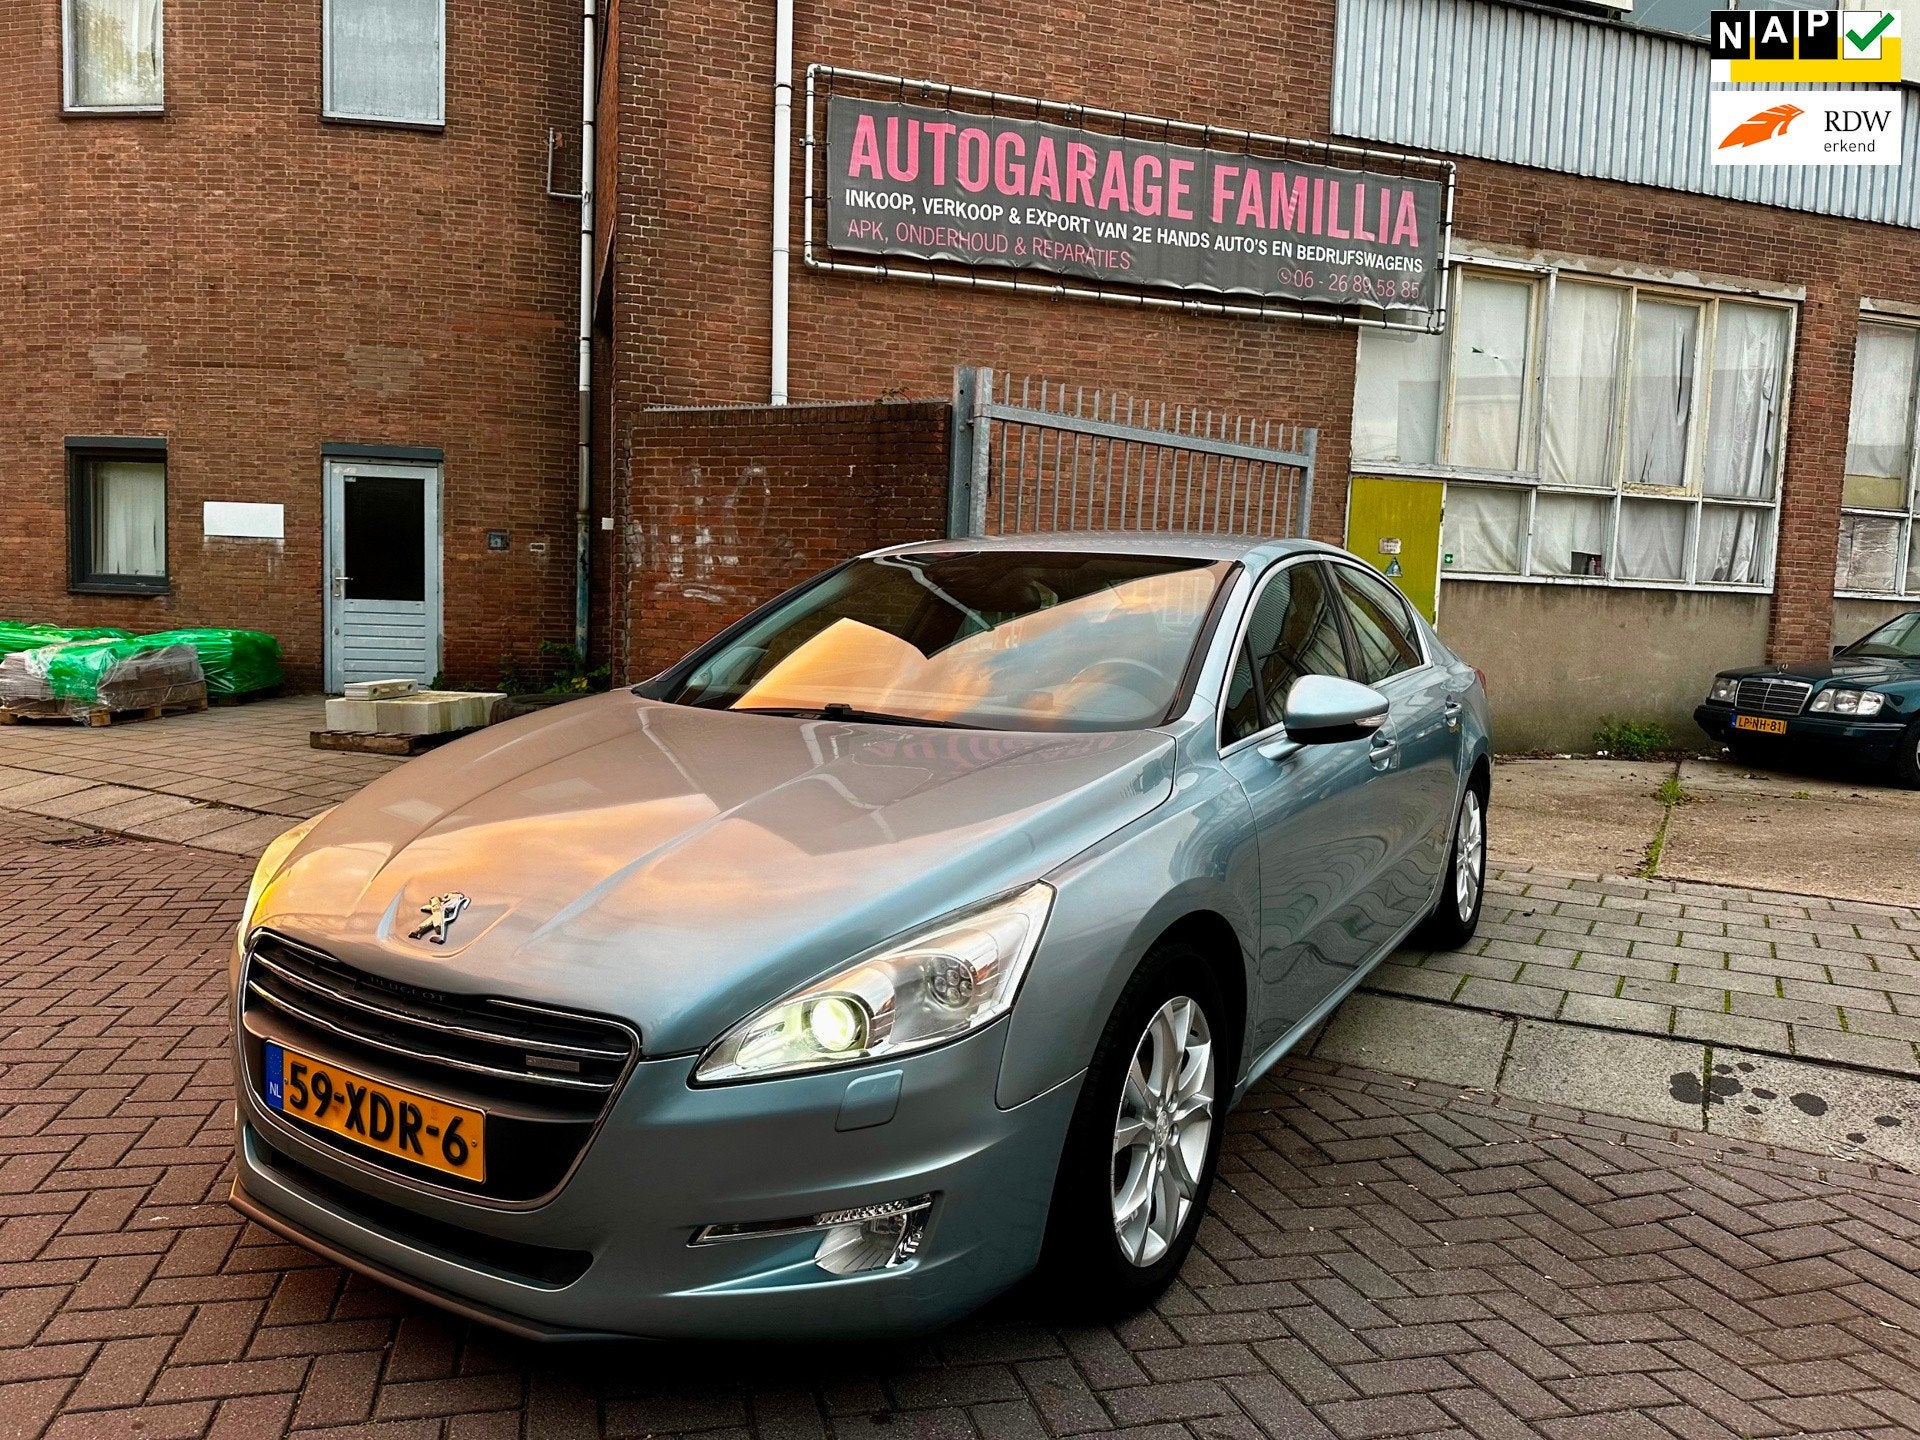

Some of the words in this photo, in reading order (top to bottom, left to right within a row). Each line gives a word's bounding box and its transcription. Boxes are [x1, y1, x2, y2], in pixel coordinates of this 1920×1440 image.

[847, 114, 1195, 220] AUTOGARAGE
[1212, 164, 1419, 248] FAMILLIA
[845, 188, 917, 215] INKOOP,
[922, 196, 1004, 222] VERKOOP
[1008, 207, 1022, 225] &
[1026, 208, 1091, 234] EXPORT
[1095, 220, 1128, 240] VAN
[1132, 225, 1152, 244] 2E
[1157, 227, 1210, 249] HANDS
[1214, 234, 1268, 255] AUTO'S
[1272, 240, 1293, 258] EN
[1296, 244, 1424, 273] BEDRIJFSWAGENS
[847, 218, 889, 243] APK,
[895, 222, 1009, 253] ONDERHOUD
[1014, 237, 1027, 256] &
[1032, 237, 1131, 270] REPARATIES
[1293, 269, 1314, 289] 06
[1328, 273, 1348, 293] 26
[1353, 275, 1371, 294] 89
[1376, 279, 1396, 297] 58
[1401, 280, 1420, 299] 85
[269, 1081, 282, 1099] NL
[290, 1061, 469, 1166] 59-XDR-6
